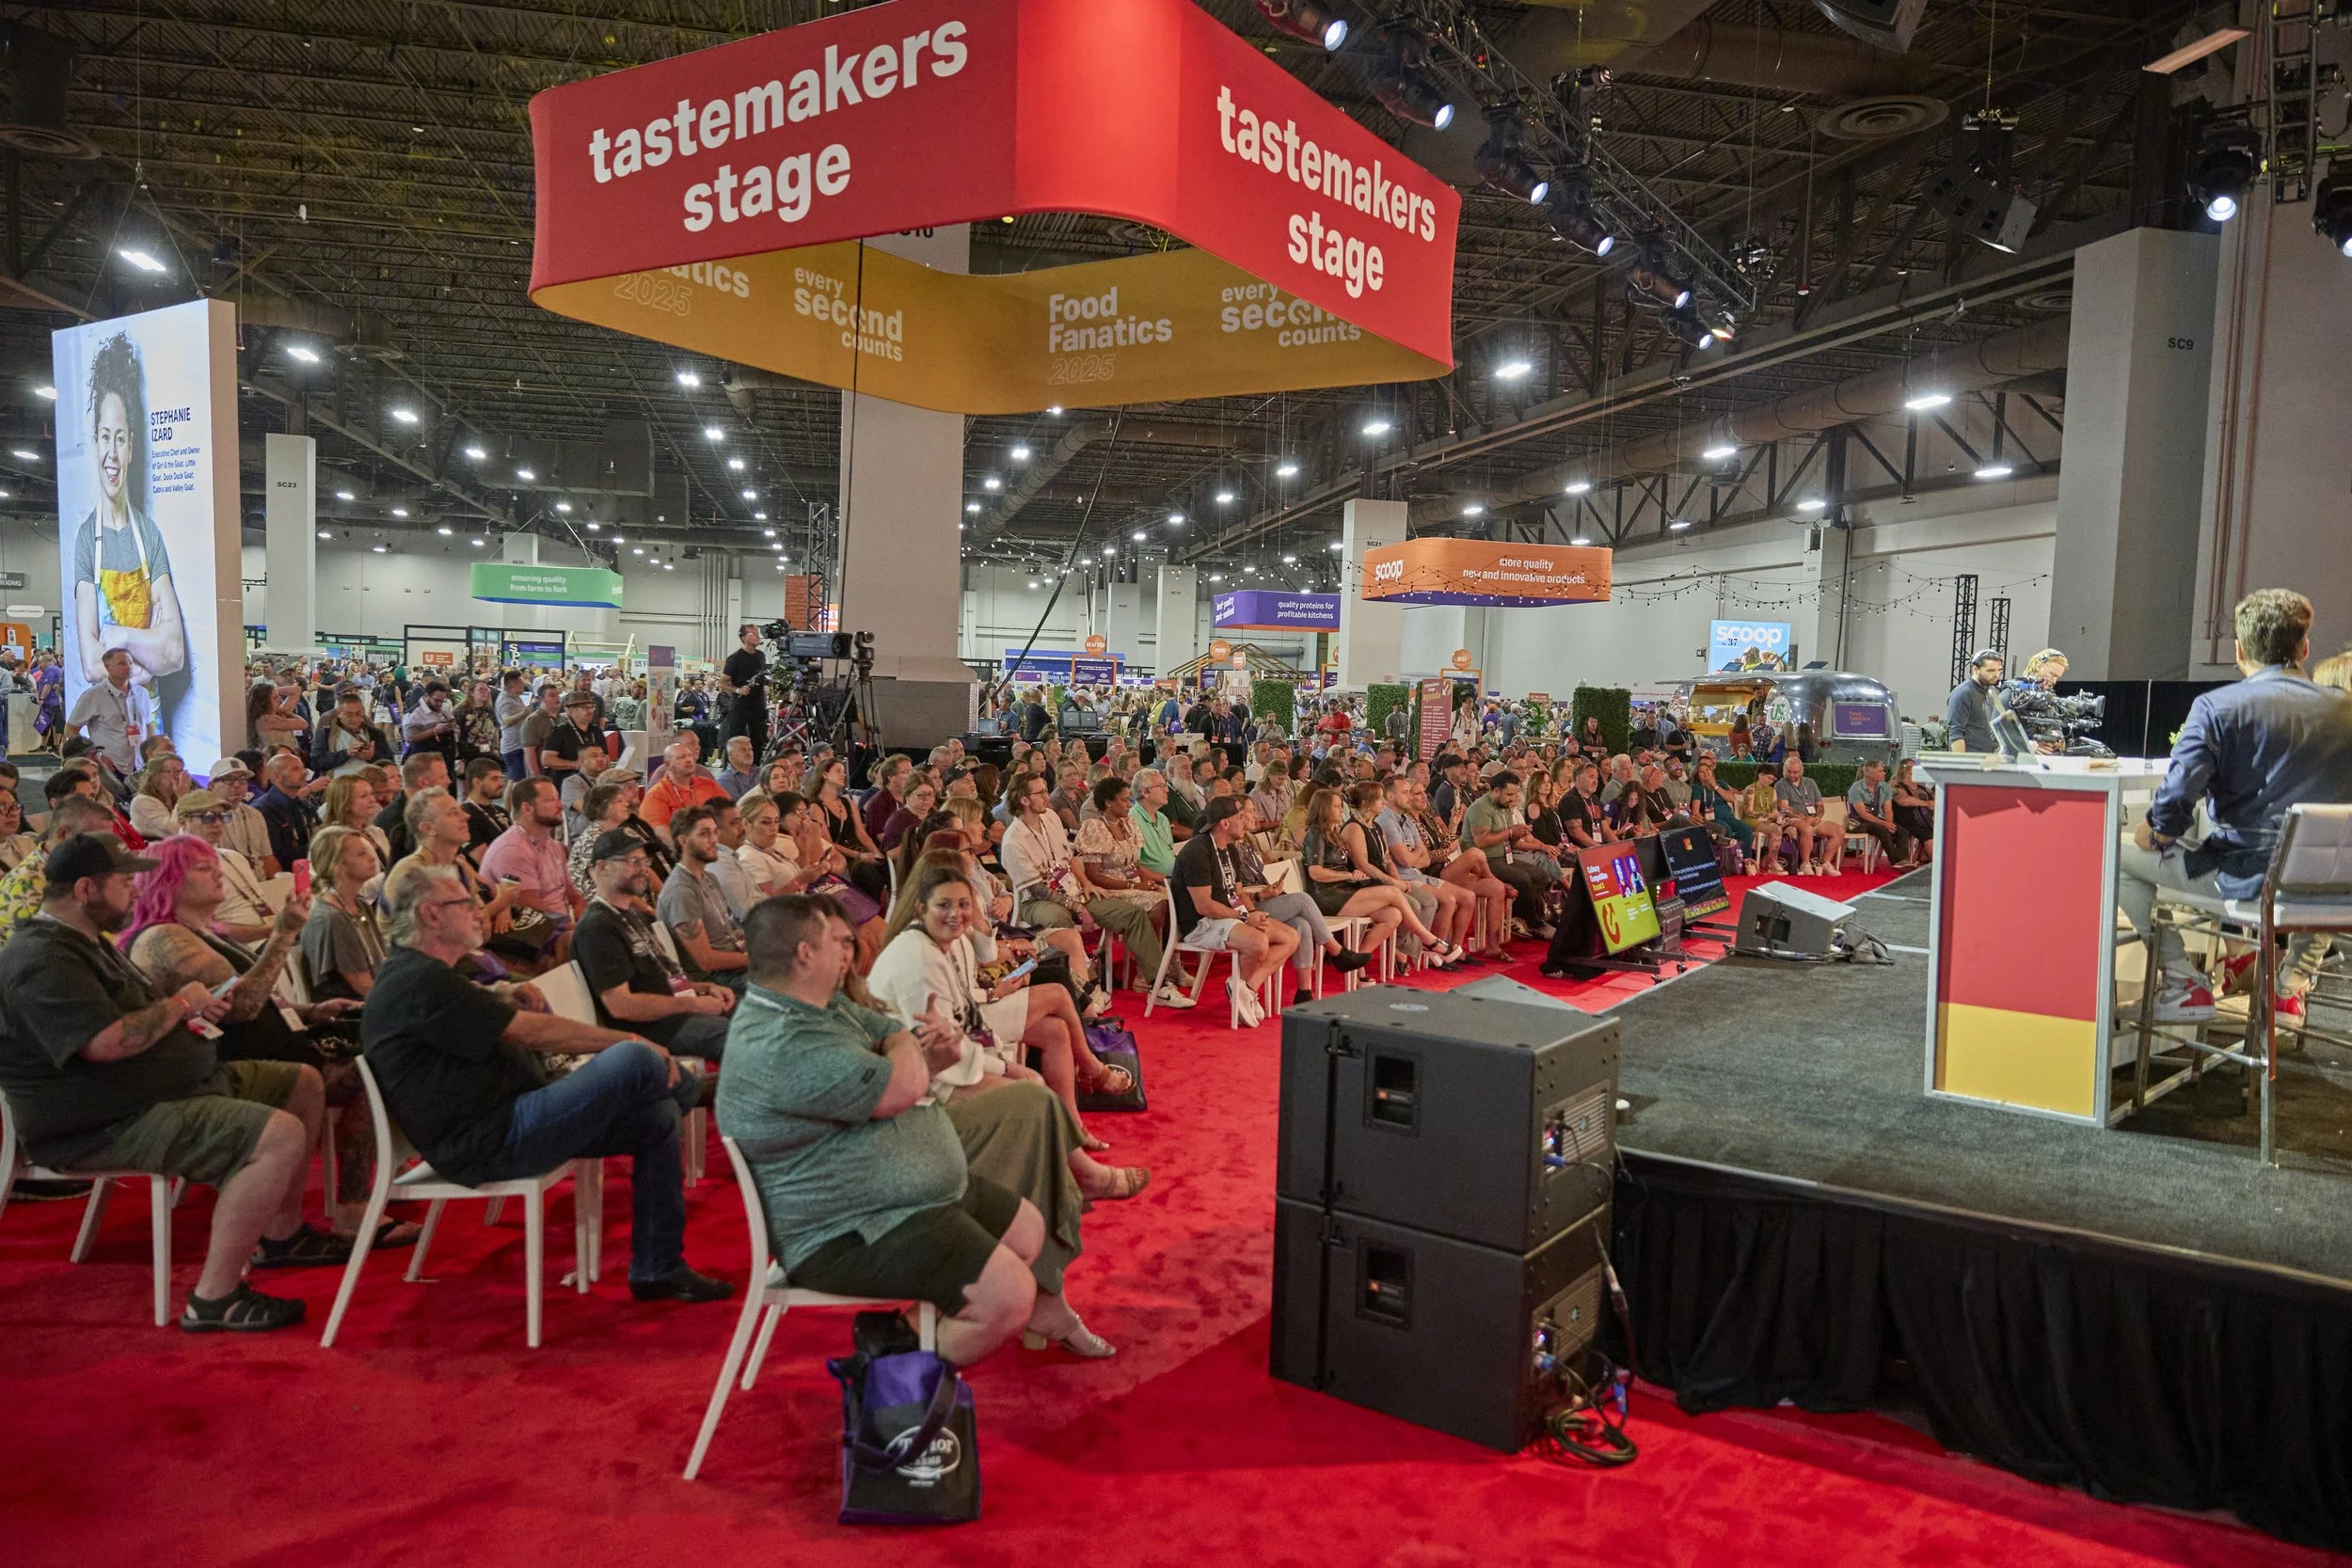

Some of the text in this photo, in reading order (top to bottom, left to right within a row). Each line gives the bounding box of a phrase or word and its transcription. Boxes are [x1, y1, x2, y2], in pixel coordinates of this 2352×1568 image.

[589, 21, 968, 183] tastemakers
[1217, 85, 1436, 242] tastemakers
[684, 143, 850, 232] stage
[1289, 211, 1384, 299] stage
[614, 273, 693, 316] 2025
[794, 267, 844, 299] every
[1221, 283, 1279, 303] every
[793, 288, 903, 342] second
[1049, 286, 1118, 323] Food
[841, 331, 903, 362] counts
[1049, 315, 1173, 353] Fanatics
[1279, 321, 1362, 347] counts
[2168, 337, 2194, 350] SC9
[1048, 354, 1117, 385] 2025
[151, 407, 191, 425] STEPHANIE
[151, 427, 173, 442] IZARD
[1375, 559, 1404, 581] scoop
[1463, 568, 1585, 585] new and innovative products
[1500, 558, 1554, 571] more quality
[511, 575, 567, 585] ensuring quality
[553, 585, 567, 594] fork
[1278, 601, 1298, 610] quality
[1299, 602, 1325, 610] proteins
[1716, 626, 1783, 648] scoop
